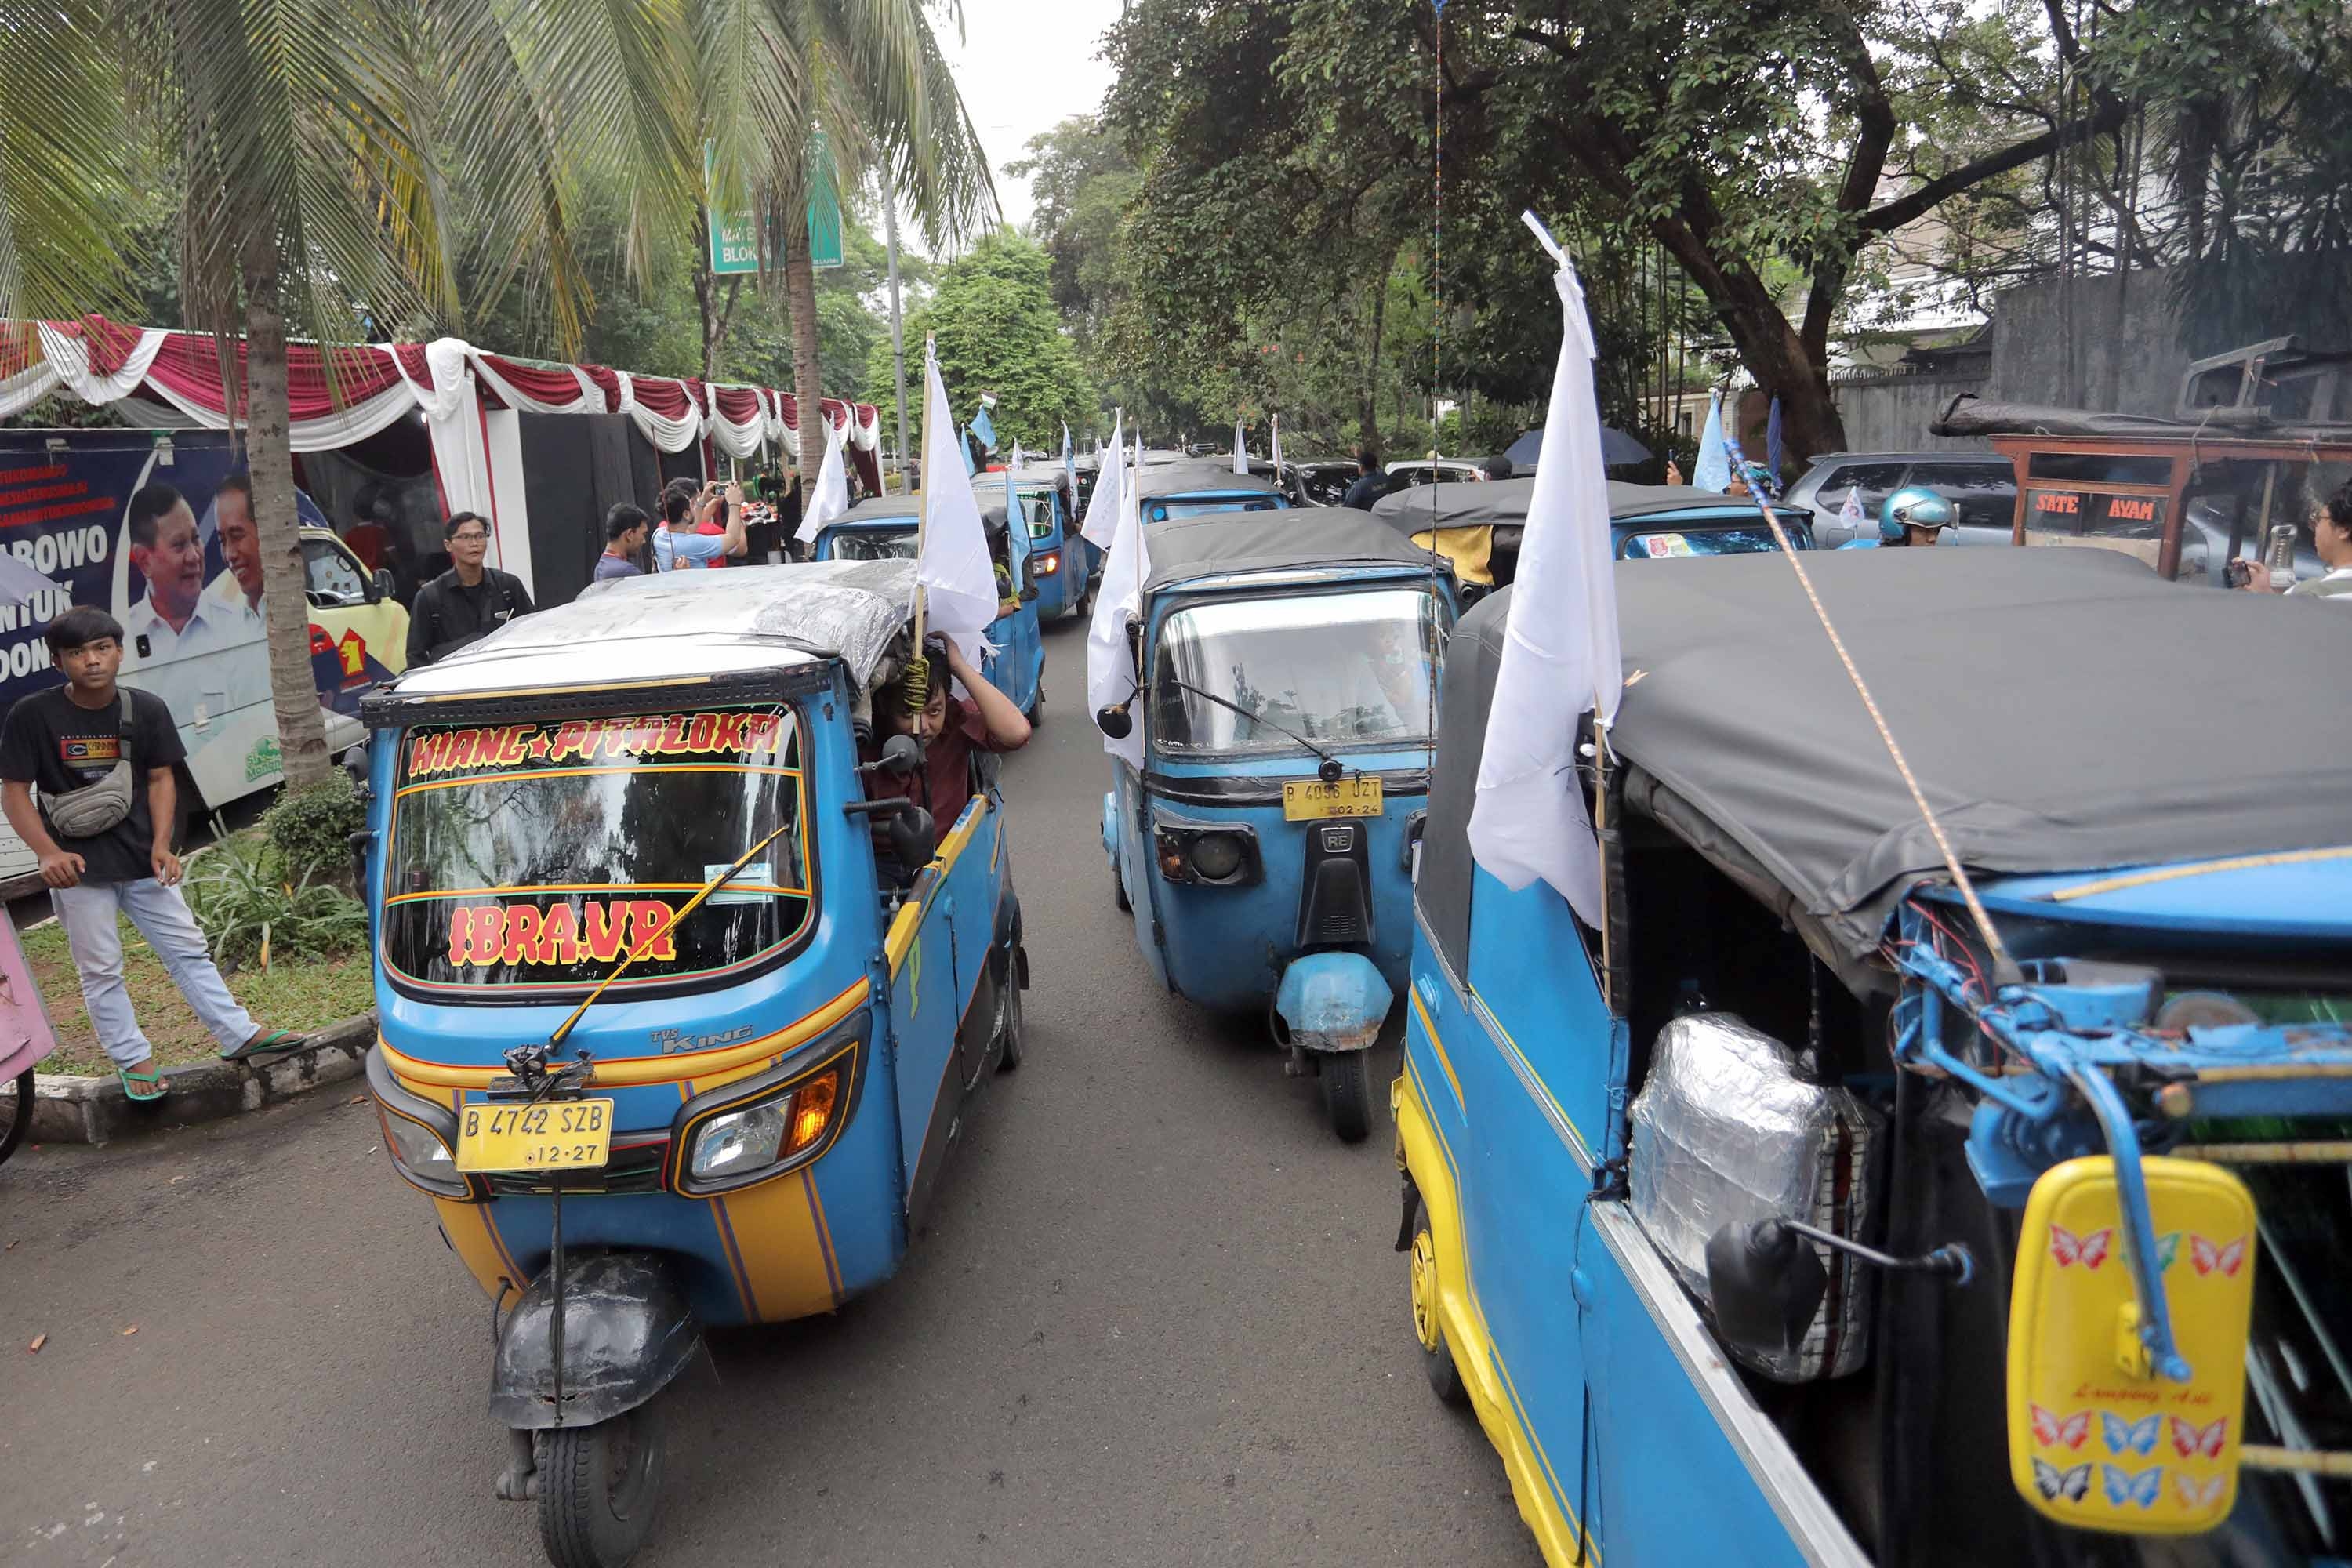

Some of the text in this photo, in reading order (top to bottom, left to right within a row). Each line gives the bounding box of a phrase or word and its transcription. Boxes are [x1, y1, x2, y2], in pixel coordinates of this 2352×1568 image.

[2035, 494, 2154, 521] SATE AYAM
[550, 713, 782, 763] PITALOKA
[1286, 786, 1294, 801] B
[1328, 835, 1348, 848] RE
[652, 1023, 753, 1054] TVS KING
[466, 1105, 604, 1137] B 4742 SZB
